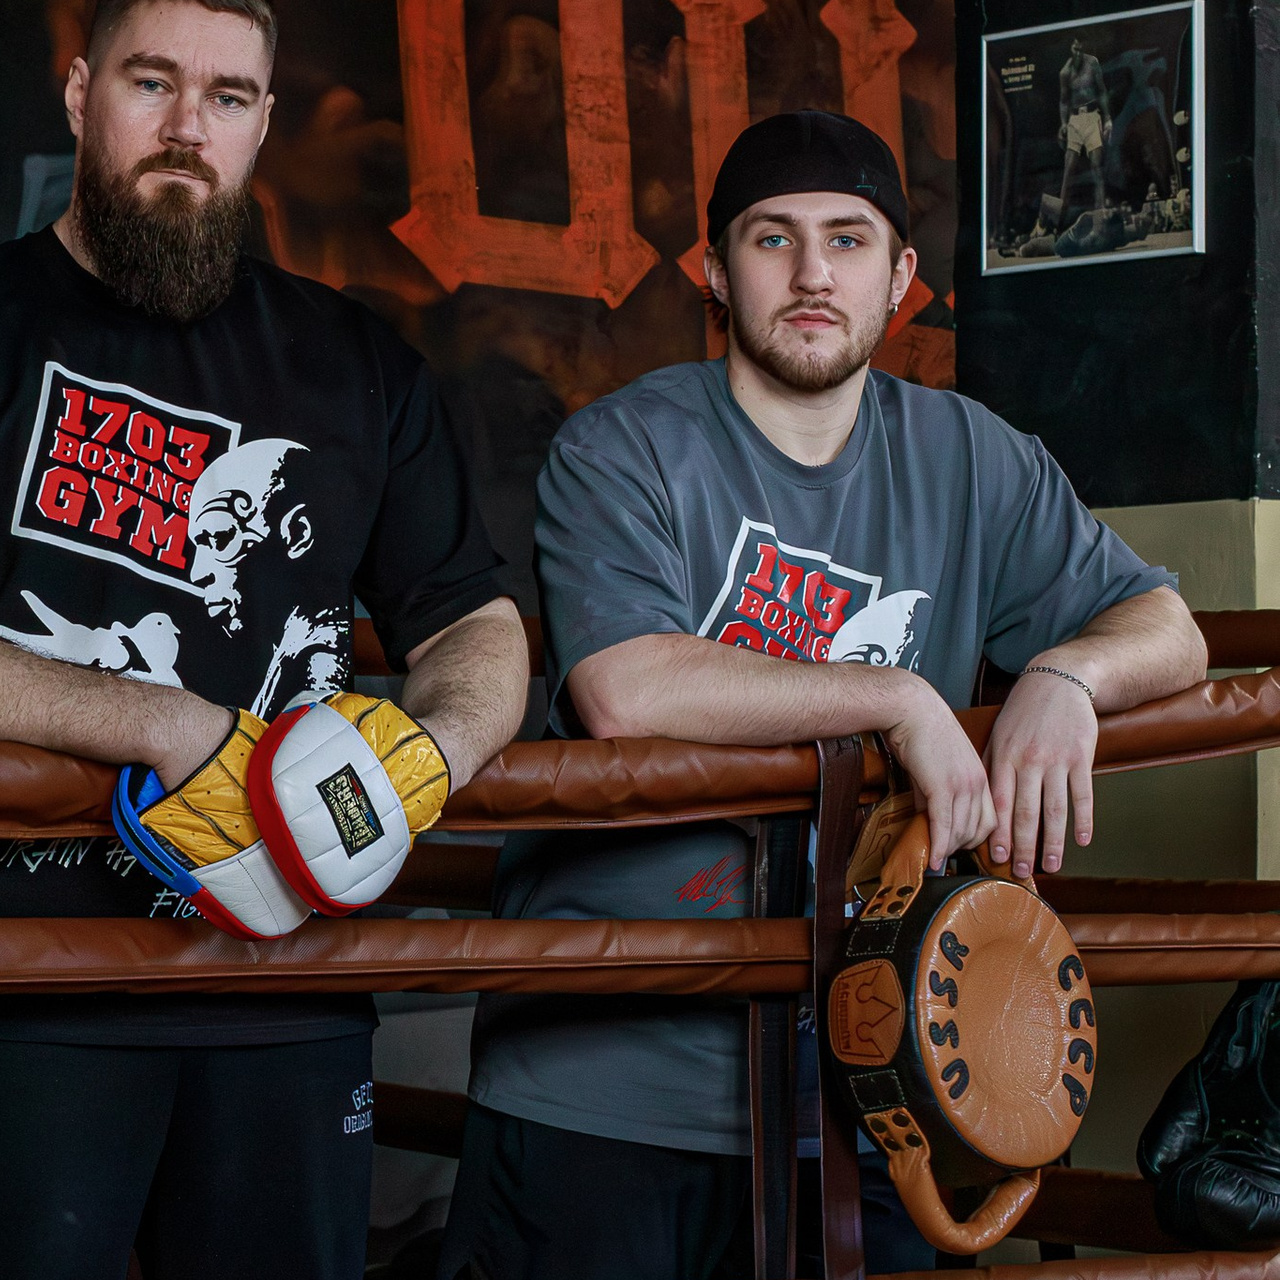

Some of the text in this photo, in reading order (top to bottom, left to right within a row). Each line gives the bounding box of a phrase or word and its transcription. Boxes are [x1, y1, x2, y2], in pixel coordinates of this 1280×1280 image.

[49, 429, 193, 513] BOXING
[58, 387, 211, 480] 1703
[36, 466, 188, 570] GYM
[928, 930, 971, 1100] USSR
